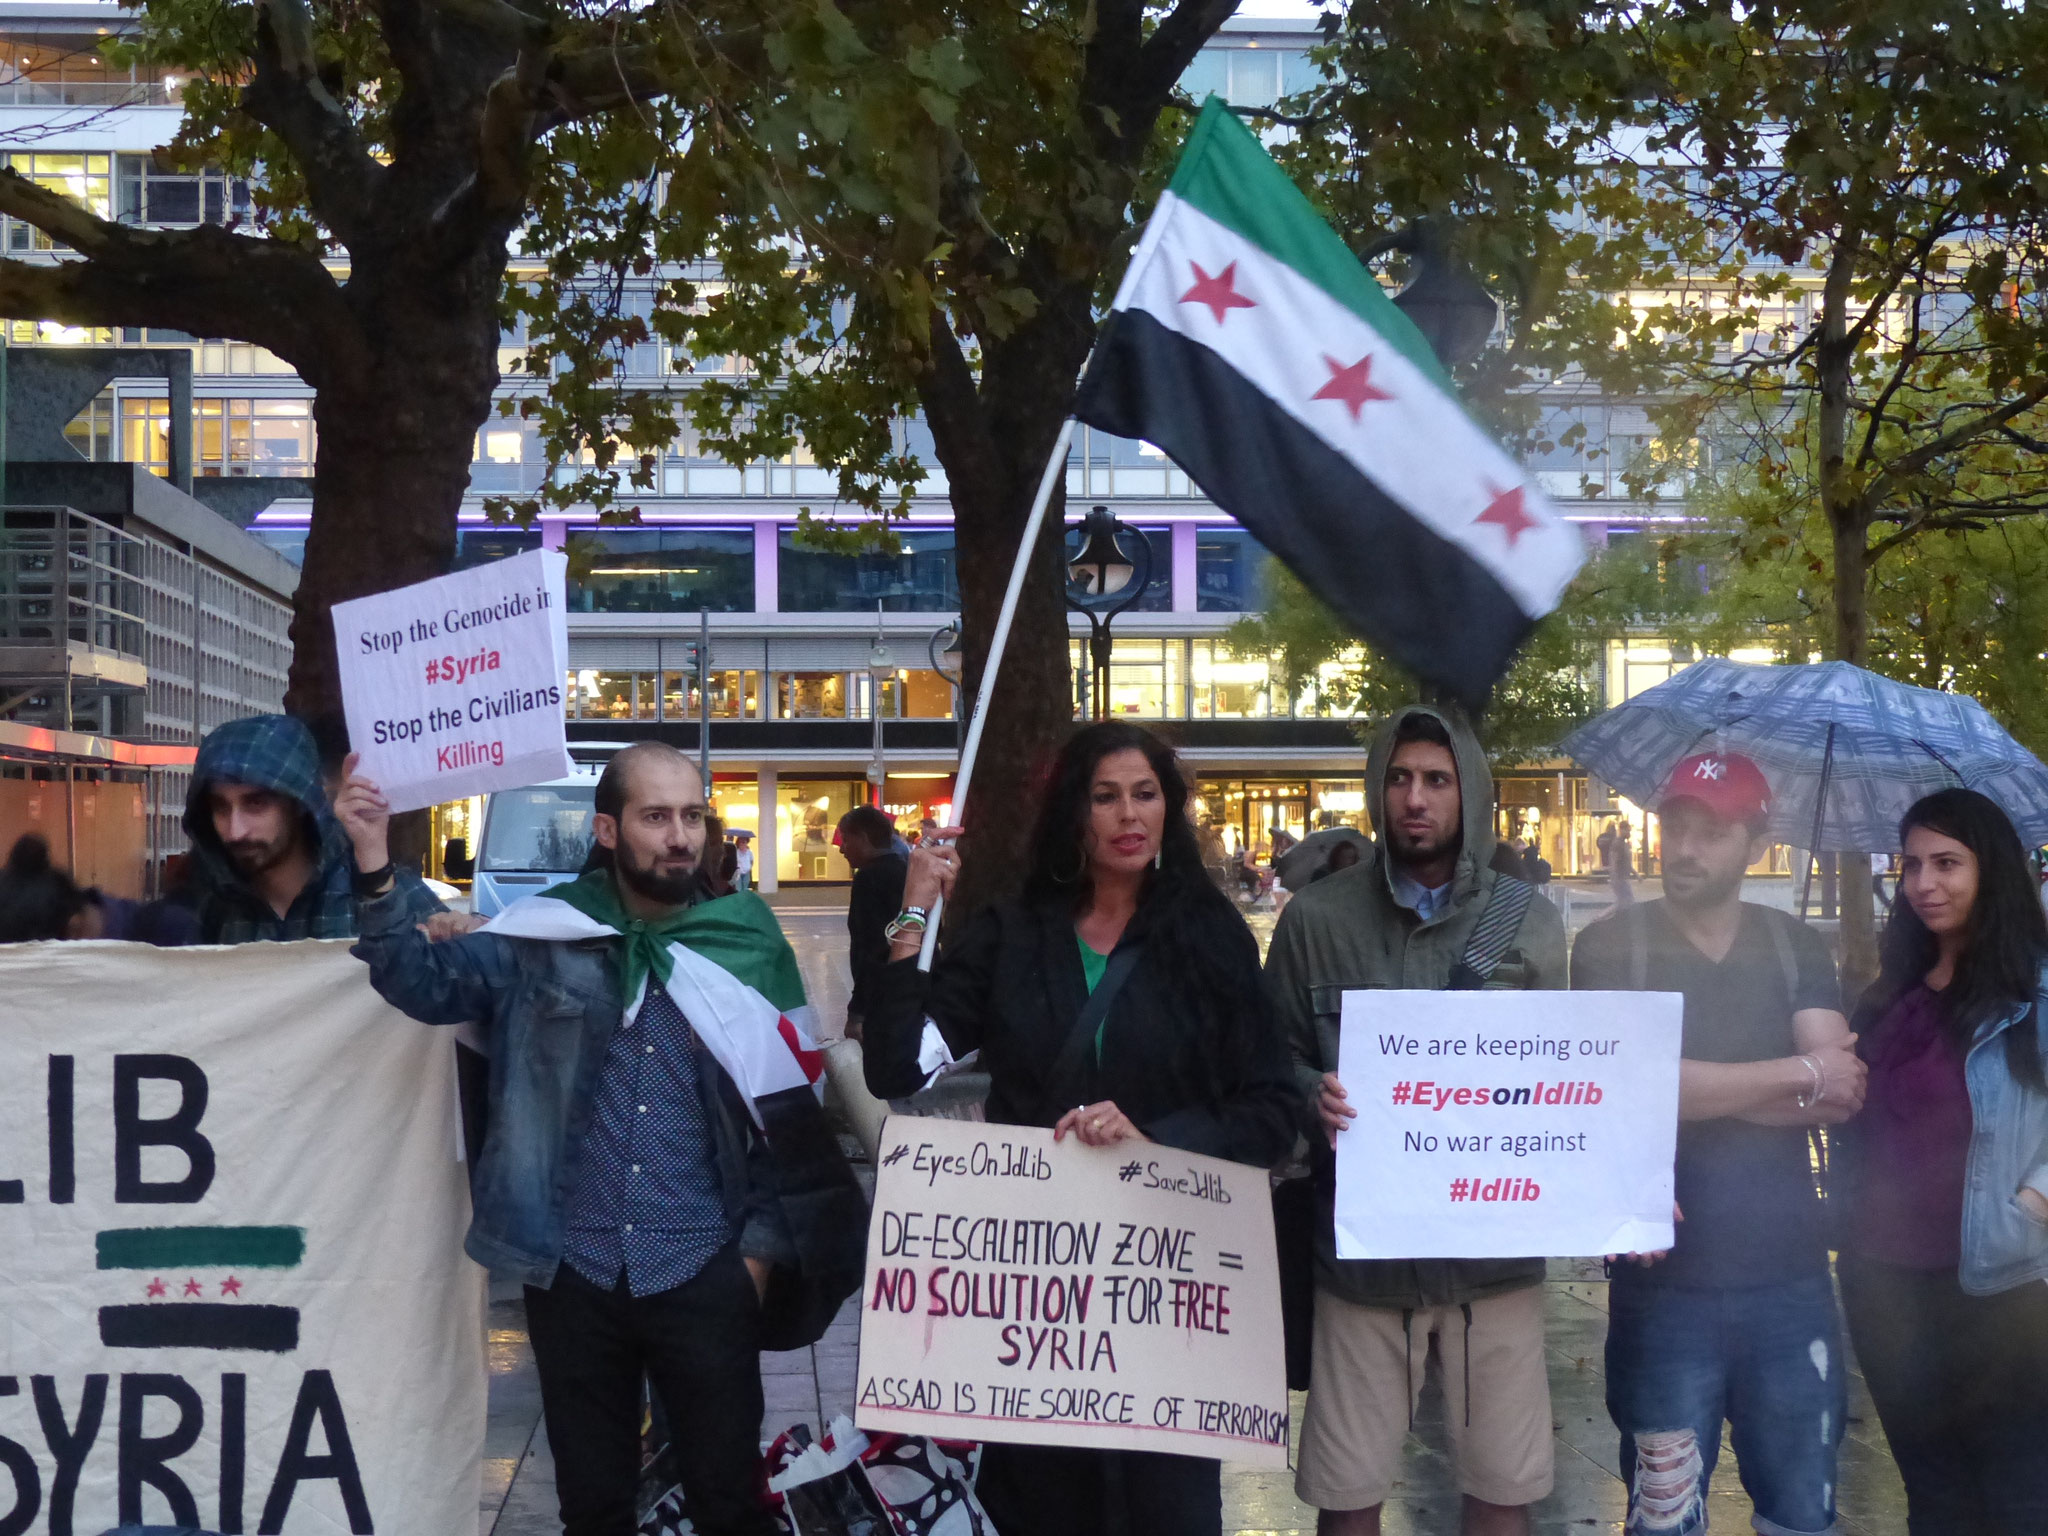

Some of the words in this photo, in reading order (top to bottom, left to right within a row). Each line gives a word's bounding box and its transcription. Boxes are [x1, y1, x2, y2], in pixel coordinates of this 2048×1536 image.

[360, 630, 403, 654] Stop
[409, 619, 438, 643] the
[444, 593, 531, 633] Genocide
[536, 587, 552, 609] in
[426, 647, 501, 685] #Syria
[374, 716, 422, 744] Stop
[429, 708, 462, 733] the
[469, 685, 561, 722] Civilians
[437, 740, 504, 772] Killing
[1378, 1033, 1419, 1056] We
[1428, 1038, 1467, 1056] are
[1476, 1033, 1570, 1060] keeping
[1579, 1038, 1620, 1056] our
[1392, 1081, 1603, 1111] #EyesonIdlib
[0, 1053, 215, 1204] IB
[1404, 1131, 1438, 1152] No
[1447, 1135, 1493, 1152] war
[1500, 1131, 1586, 1157] against
[1449, 1178, 1541, 1202] #Idlib
[881, 1210, 1101, 1265] DE-ESCALATION
[1111, 1223, 1196, 1273] ZONE
[872, 1267, 917, 1314] NO
[927, 1266, 1094, 1324] SOLUTION
[1103, 1275, 1163, 1325] FOR
[1168, 1278, 1230, 1335] FREE
[997, 1324, 1117, 1373] SYRIA
[859, 1376, 942, 1410] ASSAD
[954, 1381, 976, 1413] IS
[987, 1385, 1031, 1418] THE
[1035, 1387, 1135, 1424] SOURCE
[1153, 1396, 1185, 1429] OF
[1194, 1399, 1289, 1446] TERRORISM
